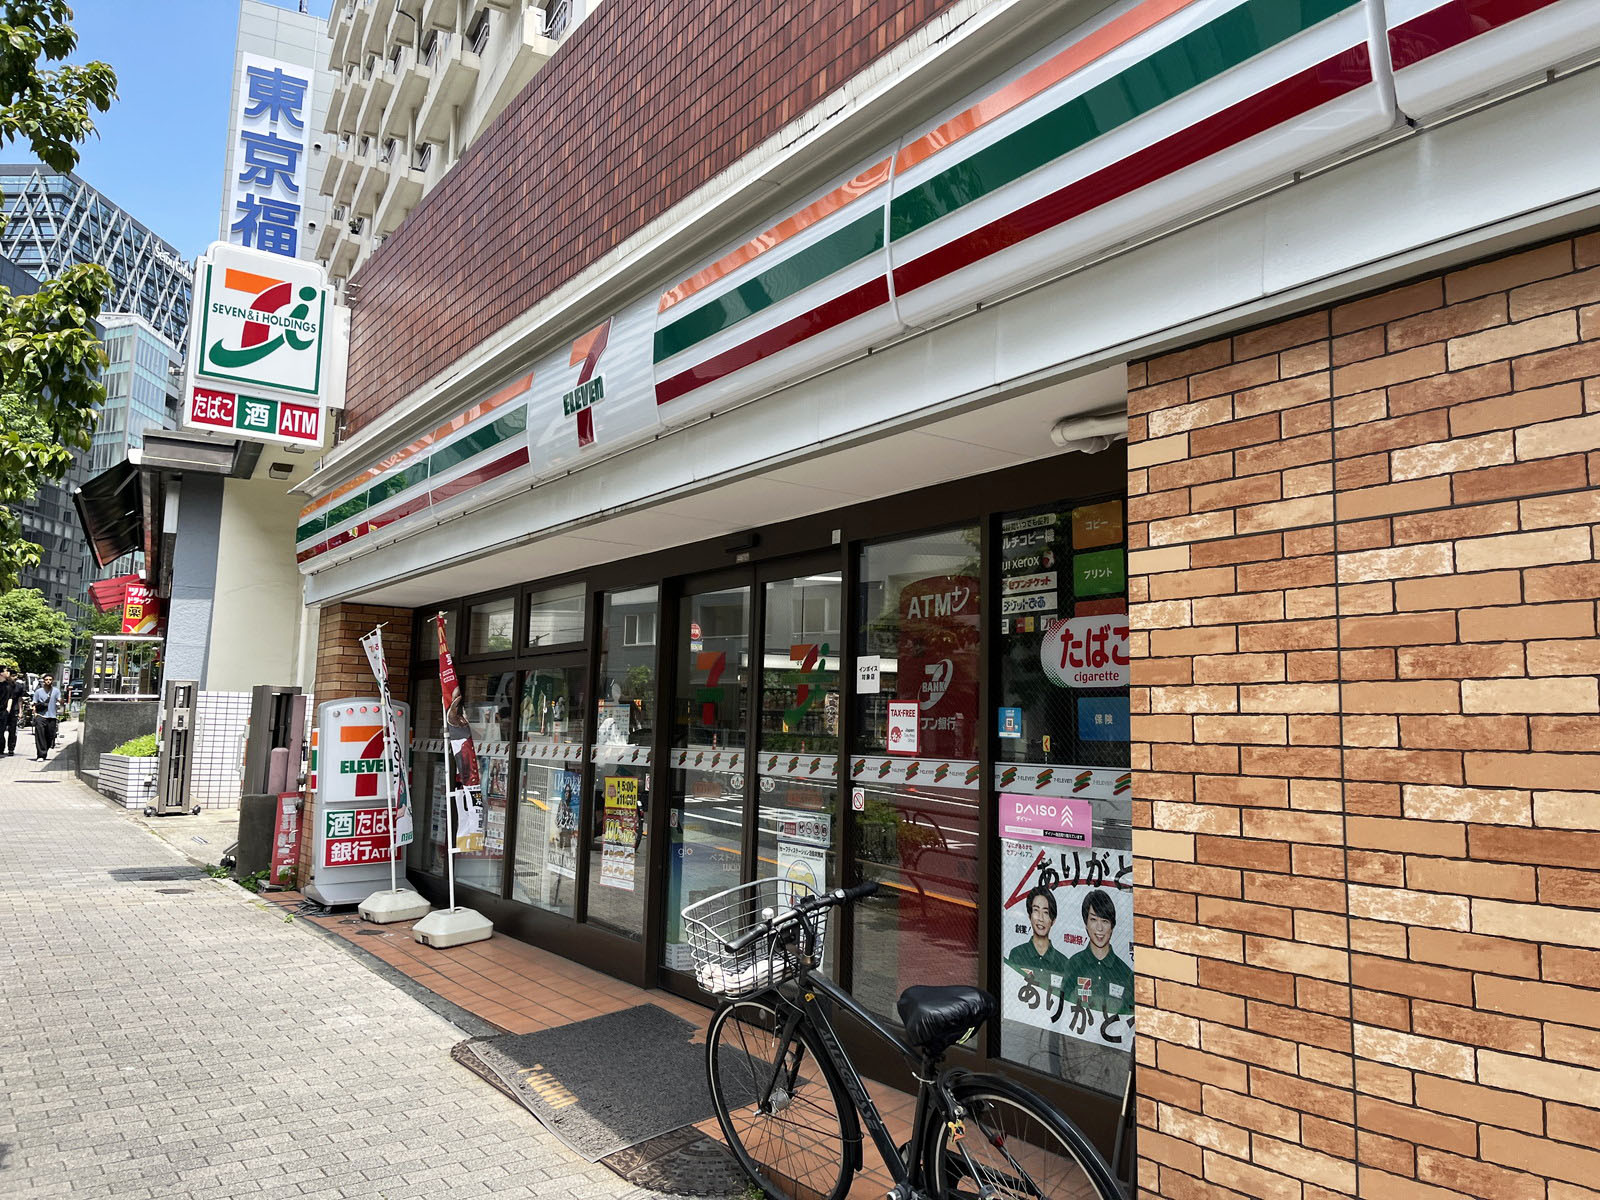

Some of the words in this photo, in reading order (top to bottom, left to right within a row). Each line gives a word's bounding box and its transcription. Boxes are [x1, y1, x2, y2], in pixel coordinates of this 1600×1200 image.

[231, 65, 308, 258] 東京福
[262, 313, 317, 334] HOLDINGS
[193, 393, 233, 421] たばこ
[243, 400, 272, 428] 酒
[280, 407, 318, 435] ATM
[1085, 519, 1109, 530] コピー
[1083, 567, 1113, 580] プリント
[1060, 623, 1130, 669] たばこ
[859, 665, 879, 673] インボイス
[1074, 670, 1120, 685] cigarette
[890, 709, 916, 718] TAX-FREE
[1094, 713, 1113, 725] 保険
[340, 758, 394, 774] ELEVEN
[1015, 803, 1057, 817] DAISO
[328, 812, 354, 838] 酒
